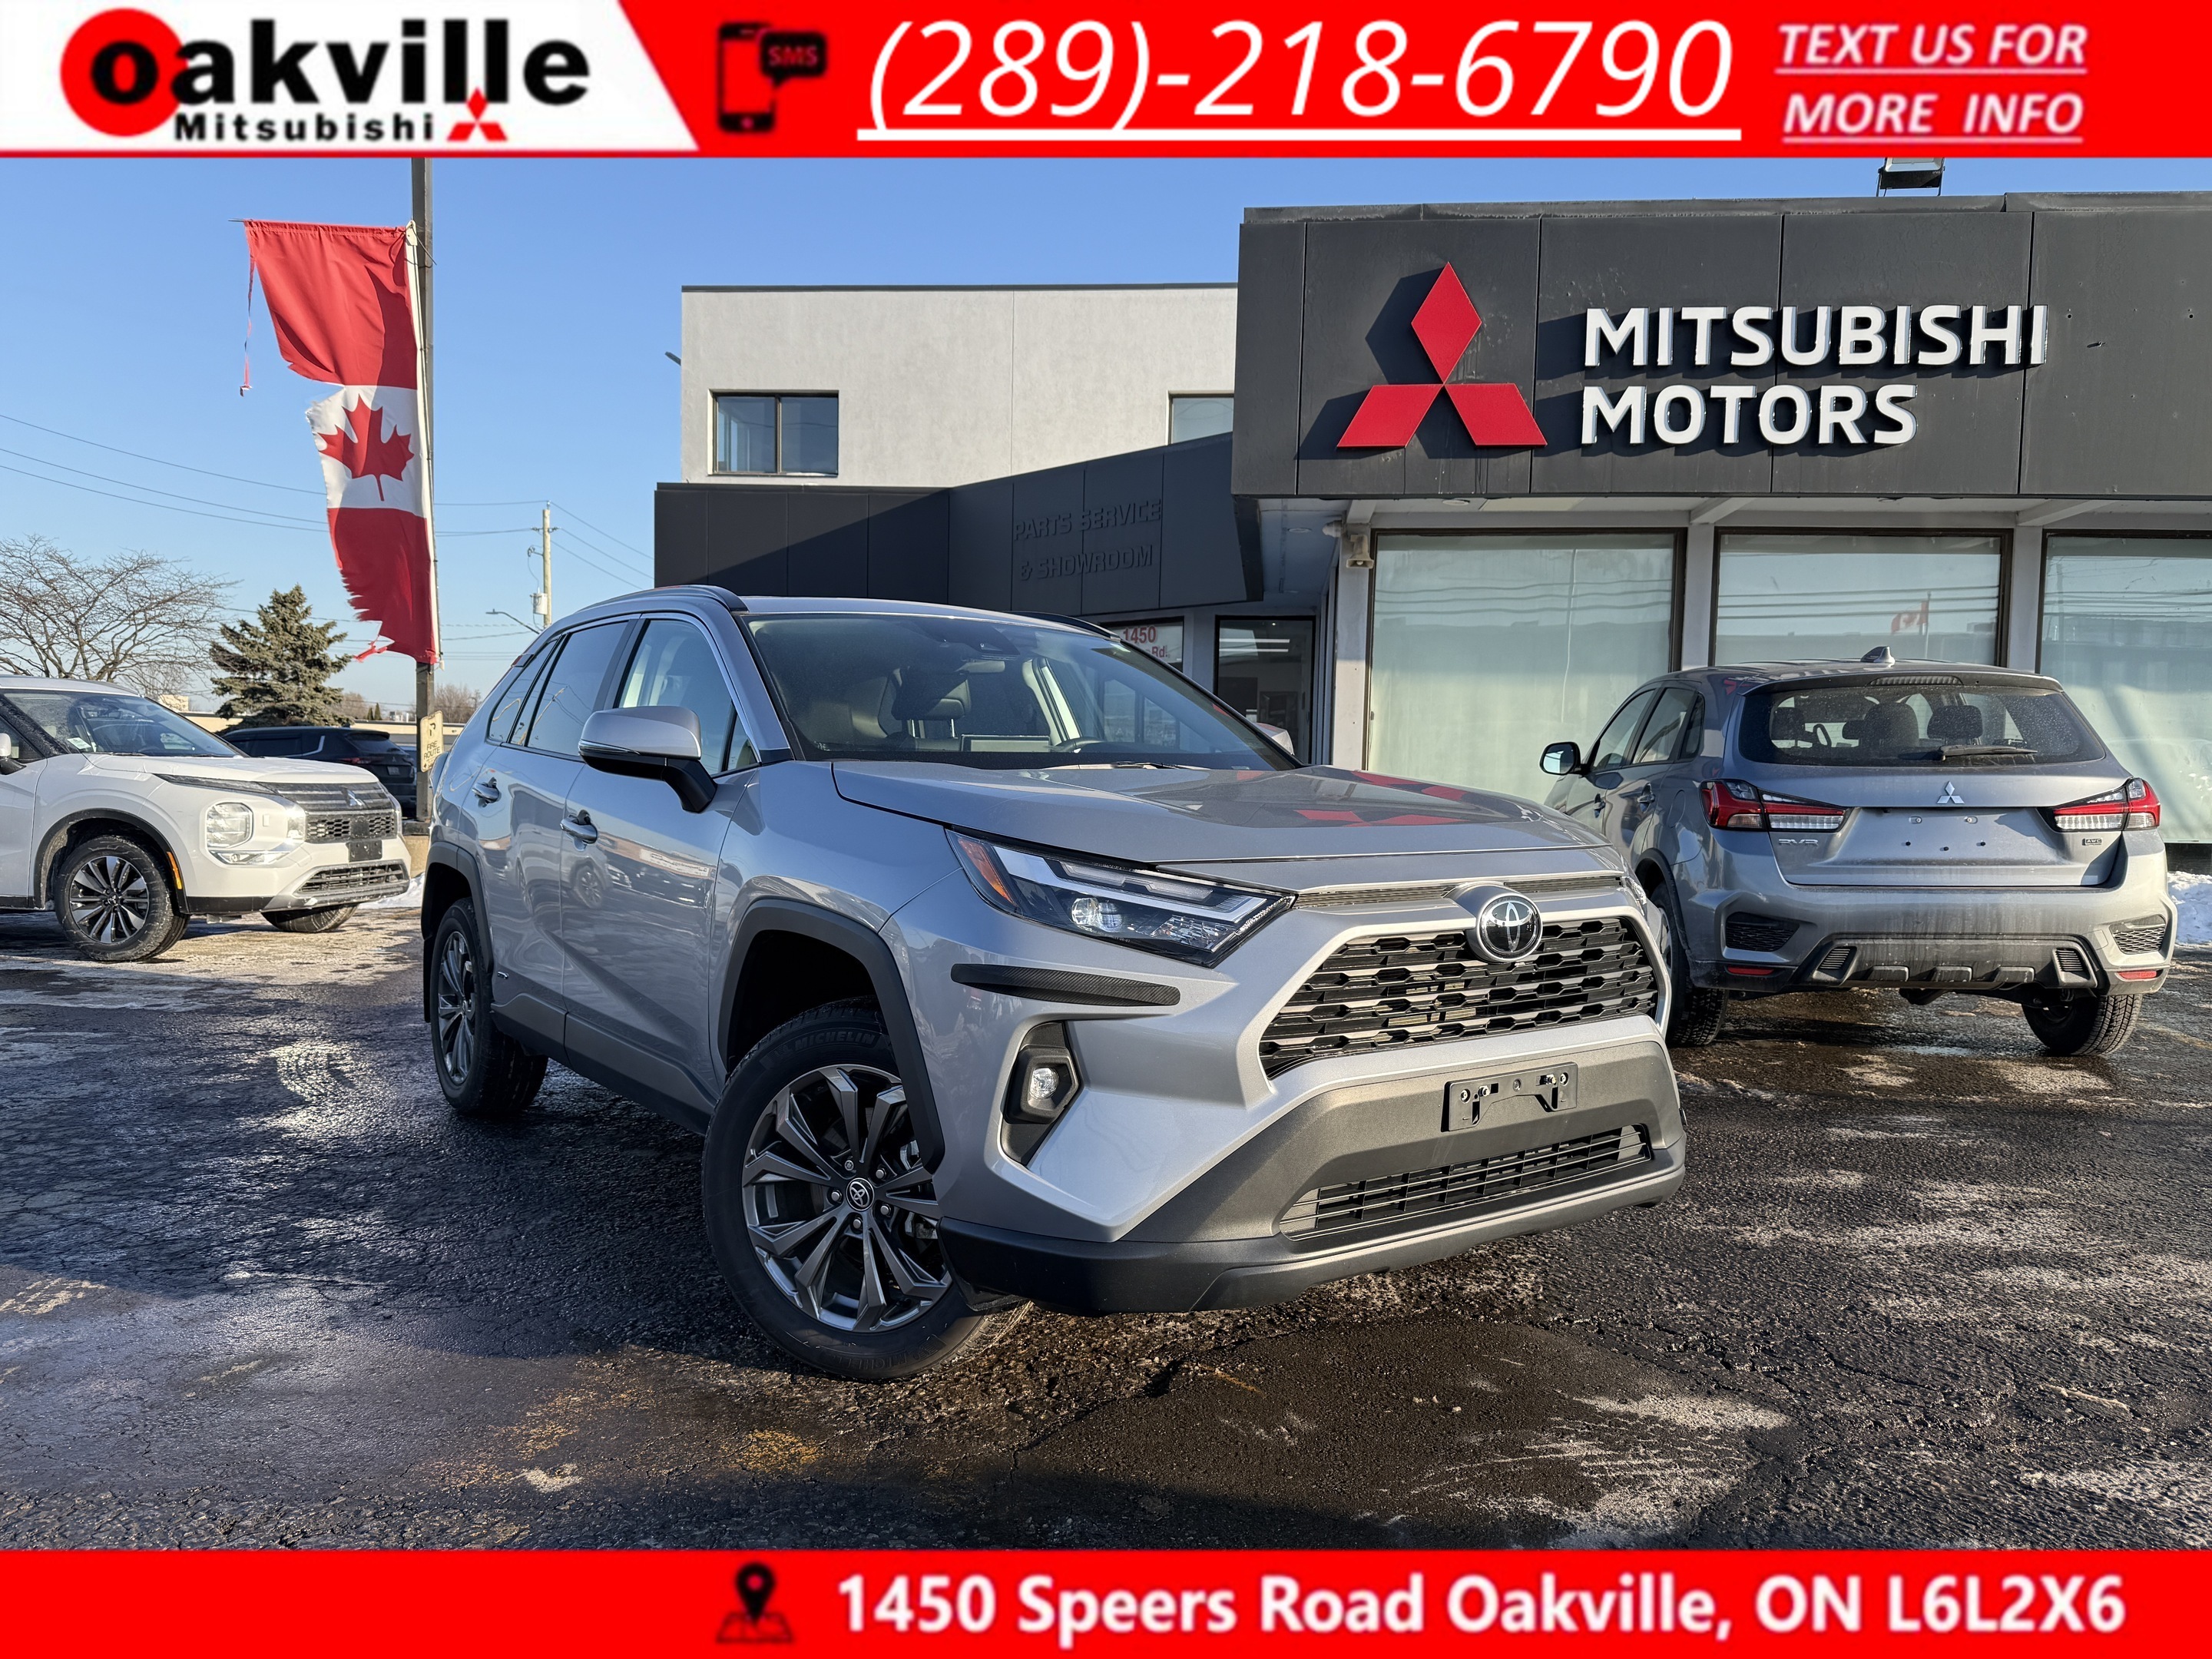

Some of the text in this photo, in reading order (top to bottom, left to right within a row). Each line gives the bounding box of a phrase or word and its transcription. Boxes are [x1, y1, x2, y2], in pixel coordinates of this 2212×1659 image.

[1584, 304, 2049, 367] MITSUBISHI
[1581, 384, 1919, 445] MOTORS
[1014, 498, 1161, 541] PARTS SERVICE
[1021, 545, 1153, 581] & SHOWROOM
[1123, 625, 1157, 644] 1450
[794, 1031, 876, 1051] MICHELIN
